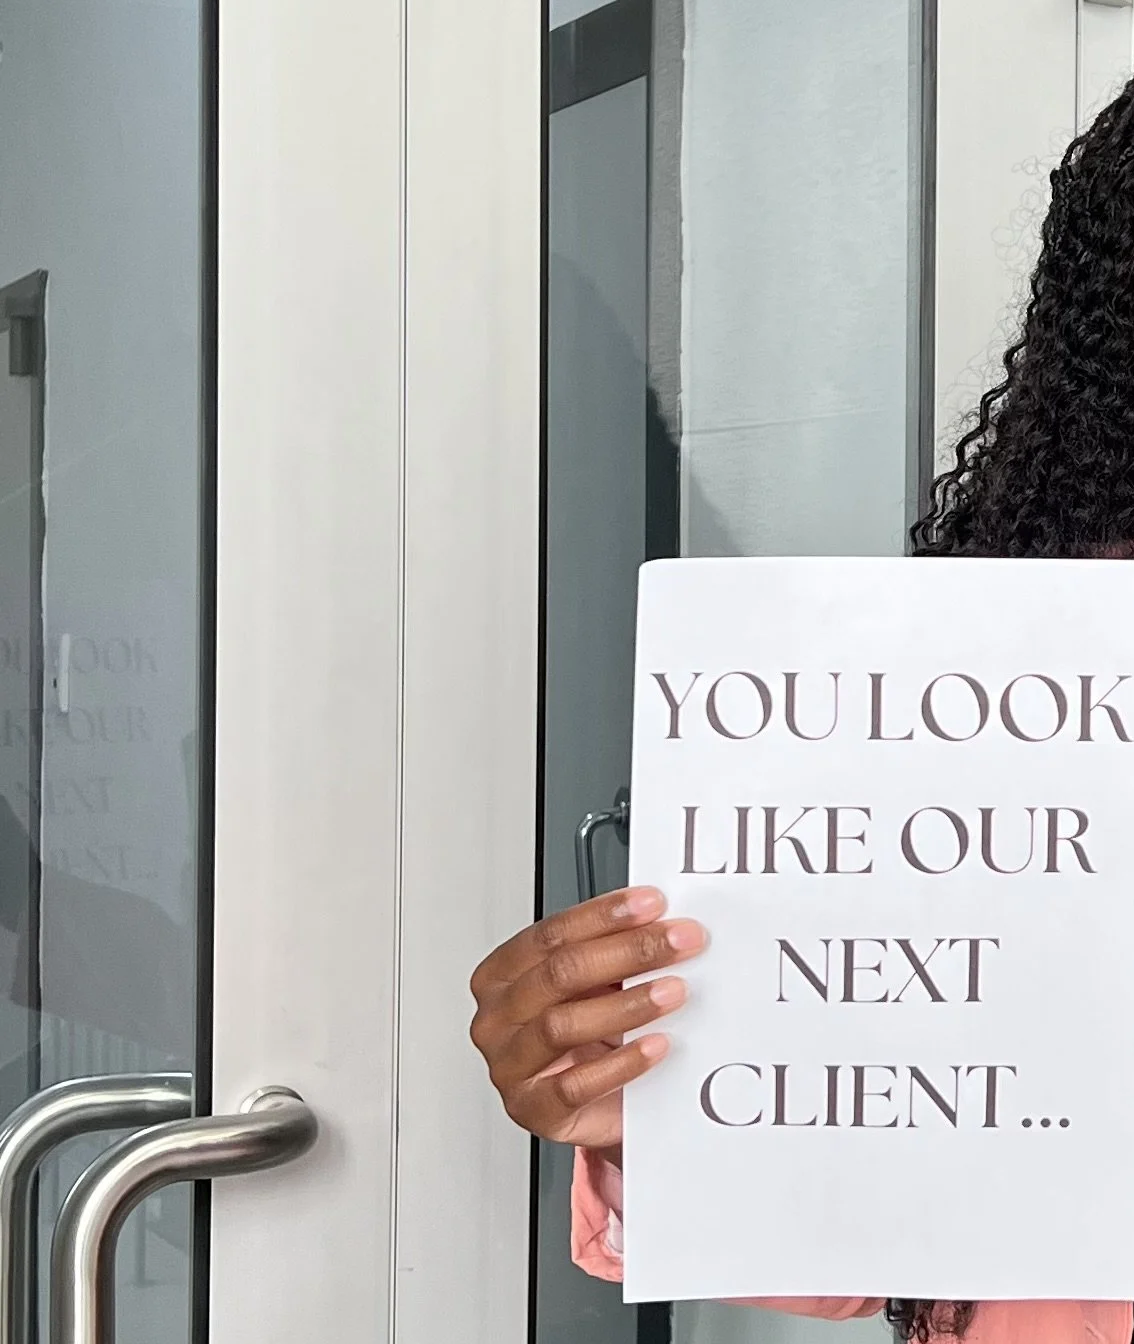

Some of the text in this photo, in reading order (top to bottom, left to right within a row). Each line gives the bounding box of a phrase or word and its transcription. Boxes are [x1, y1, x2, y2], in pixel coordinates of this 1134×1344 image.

[650, 671, 1134, 743] YOU LOOK
[680, 806, 1099, 875] LIKE OUR
[775, 938, 1001, 1004] NEXT
[700, 1062, 1071, 1129] CLIENT...
